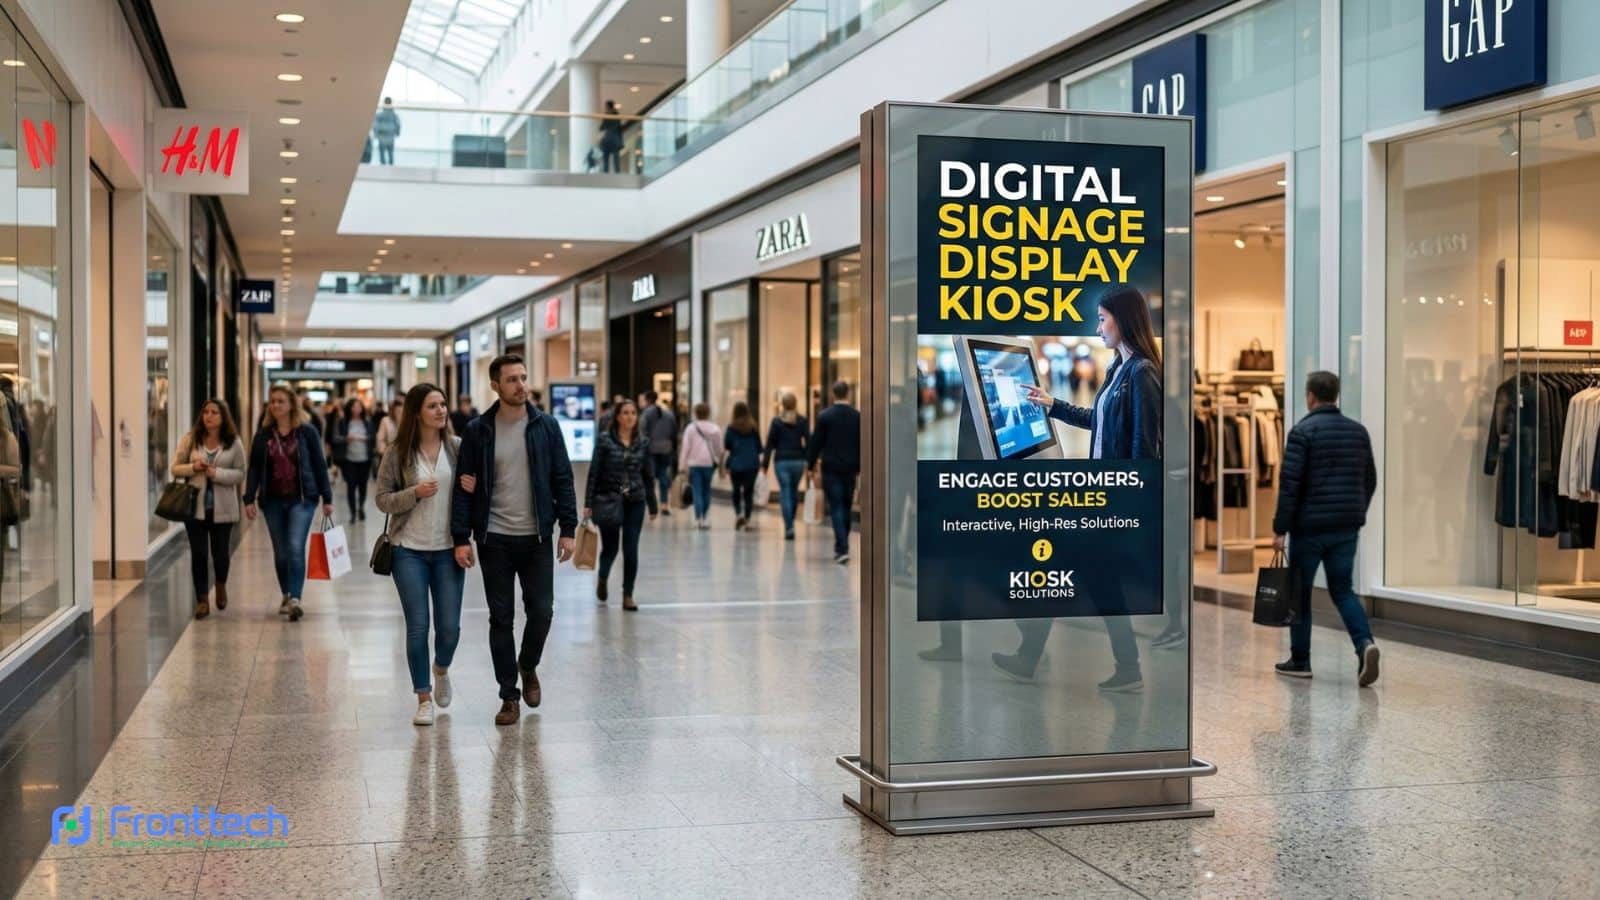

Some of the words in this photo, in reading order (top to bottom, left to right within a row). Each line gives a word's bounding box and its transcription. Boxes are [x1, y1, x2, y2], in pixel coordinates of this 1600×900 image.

[1442, 0, 1513, 63] GAP
[160, 126, 240, 177] H&M
[940, 161, 1136, 204] DIGITAL
[756, 213, 812, 261] ZARA
[938, 203, 1145, 245] SIGNAGE
[940, 244, 1138, 283] DISPLAY
[940, 285, 1083, 322] KIOSK
[939, 472, 1018, 488] ENGAGE
[1023, 471, 1144, 488] CUSTOMERS,
[977, 492, 1043, 508] BOOST
[1048, 491, 1107, 507] SALES
[943, 517, 1015, 532] Interactive,
[1019, 517, 1077, 533] High-Res
[1080, 516, 1140, 529] Solutions
[1009, 588, 1075, 599] SOLUTIONS
[1010, 570, 1074, 588] KIOSK
